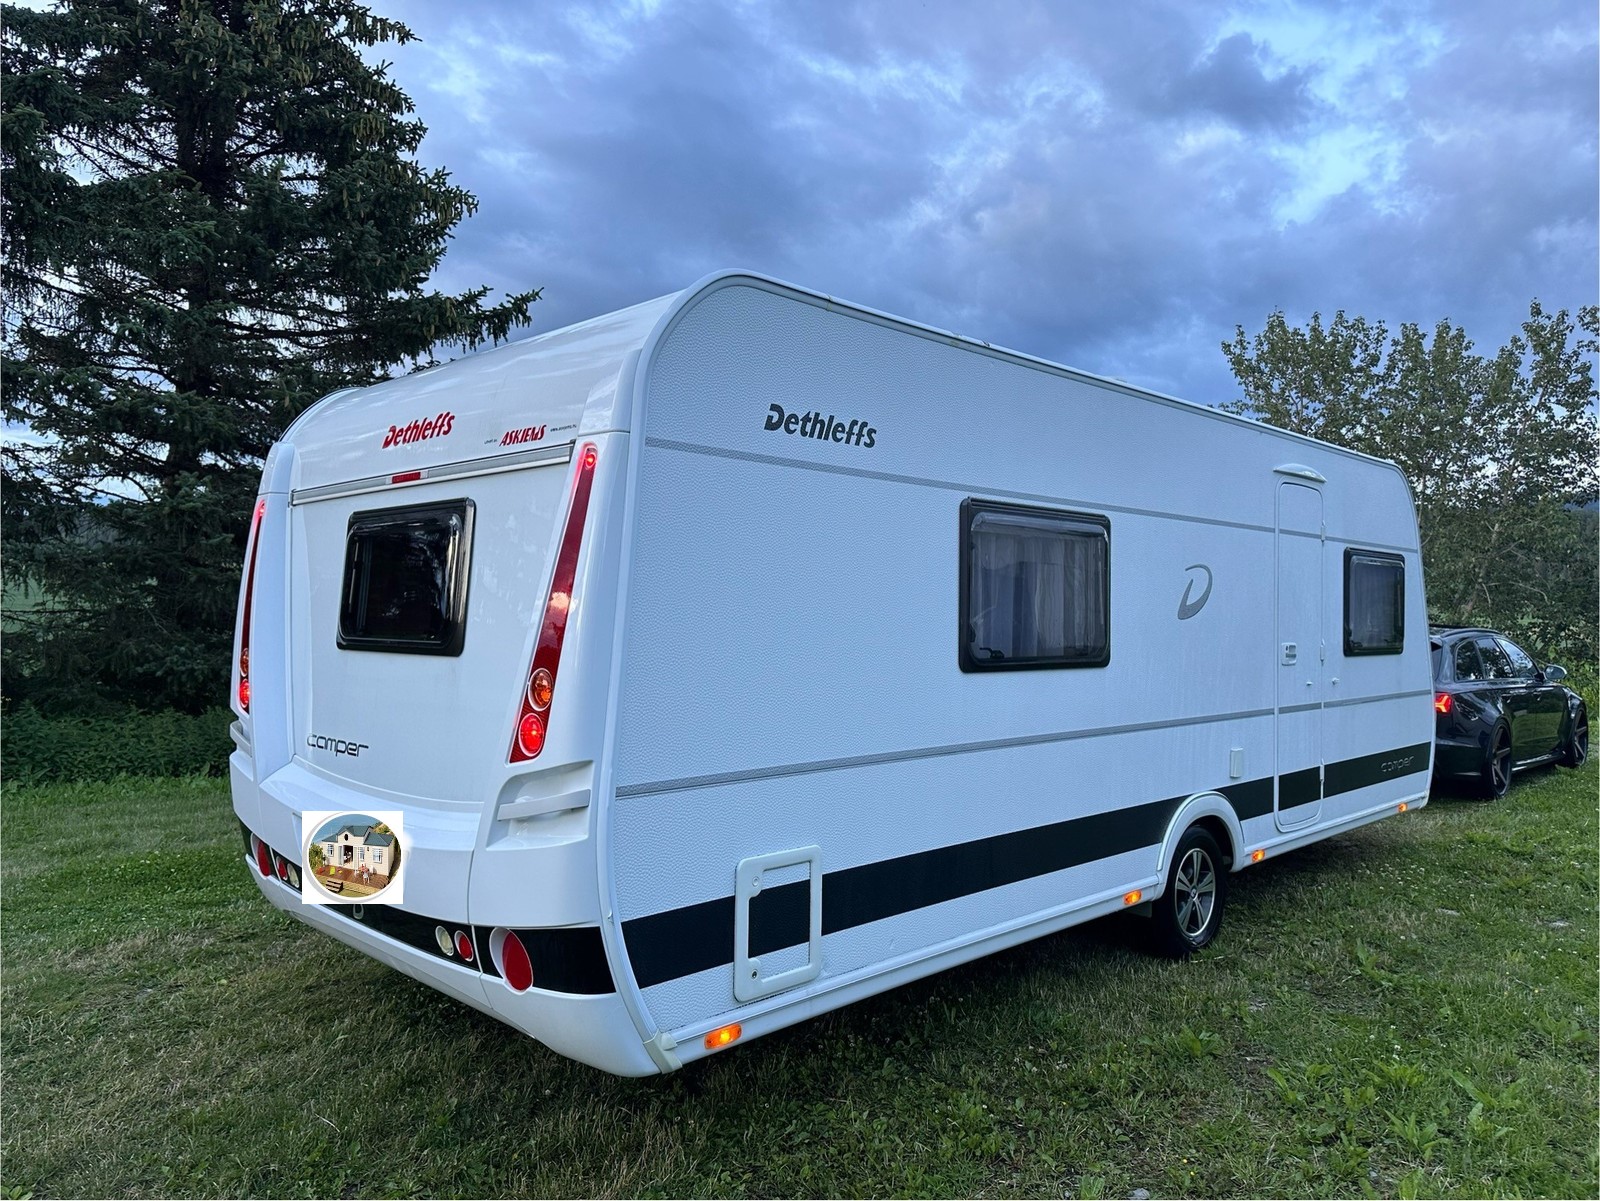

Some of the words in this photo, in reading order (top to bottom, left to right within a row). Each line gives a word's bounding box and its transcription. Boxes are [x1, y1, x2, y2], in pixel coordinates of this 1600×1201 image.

[382, 411, 455, 449] Dethleffs
[764, 403, 877, 448] Dethleffs
[306, 734, 369, 757] camper
[1381, 756, 1415, 772] camper
